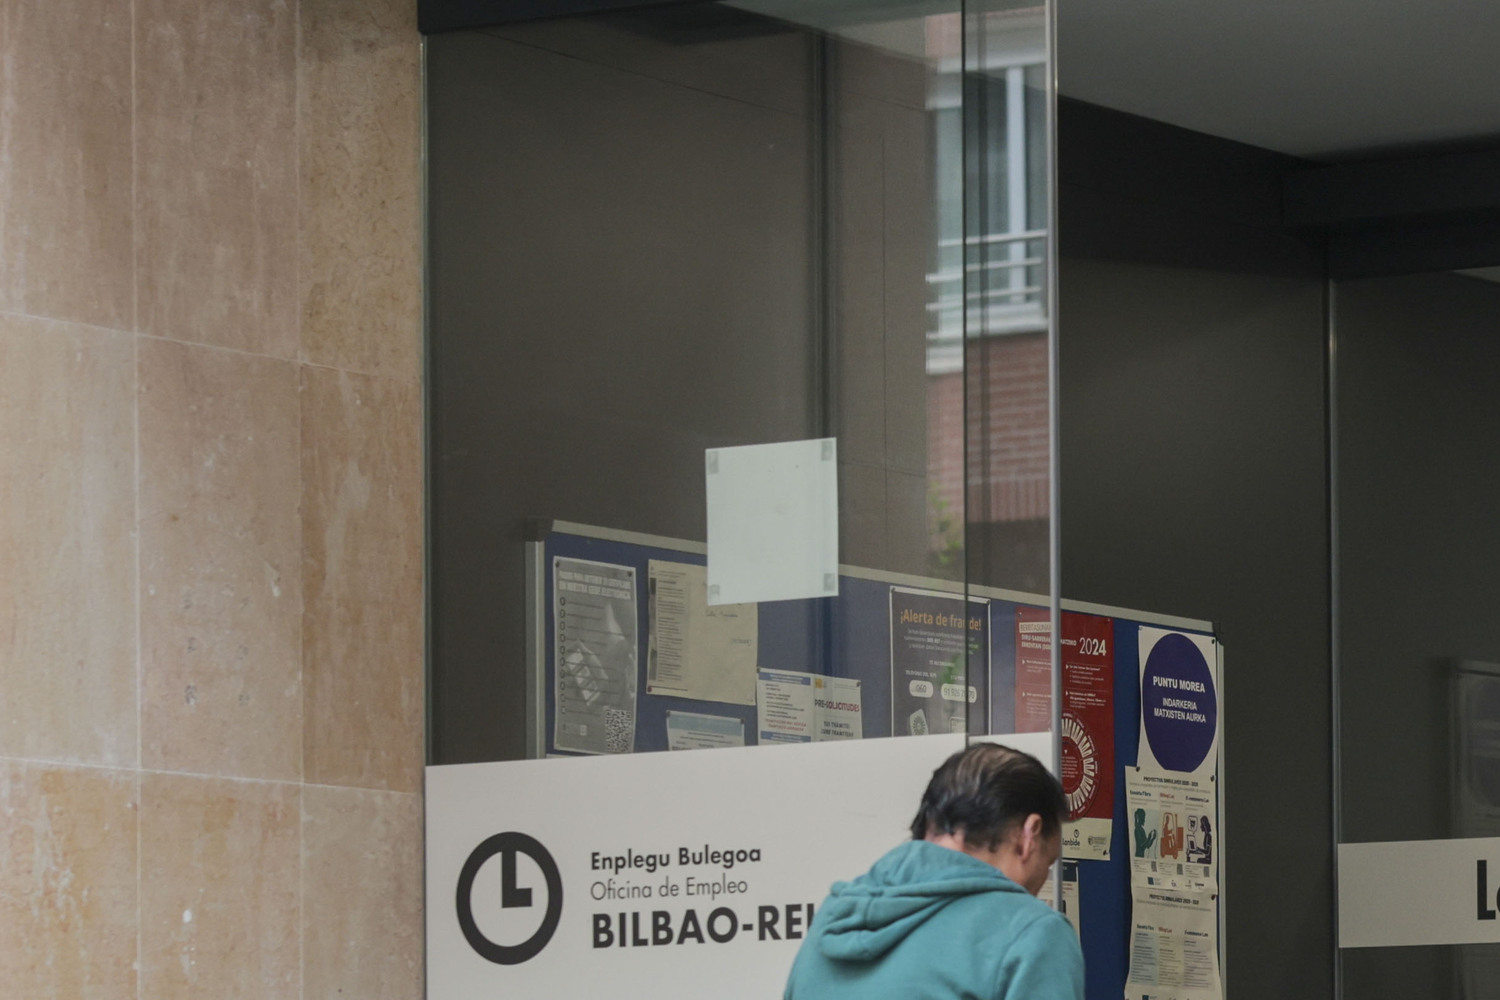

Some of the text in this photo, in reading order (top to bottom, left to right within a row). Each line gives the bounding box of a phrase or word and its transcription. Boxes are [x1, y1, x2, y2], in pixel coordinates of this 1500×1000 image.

[935, 612, 948, 627] de
[1079, 636, 1107, 656] 2024
[1152, 675, 1206, 693] PUNTU MOREA
[1162, 697, 1198, 711] INDARKERIA
[1153, 707, 1207, 724] MATXISTEN AURKA
[591, 844, 761, 875] Enplegu Bulegoa
[590, 872, 748, 901] Oficina de Empleo
